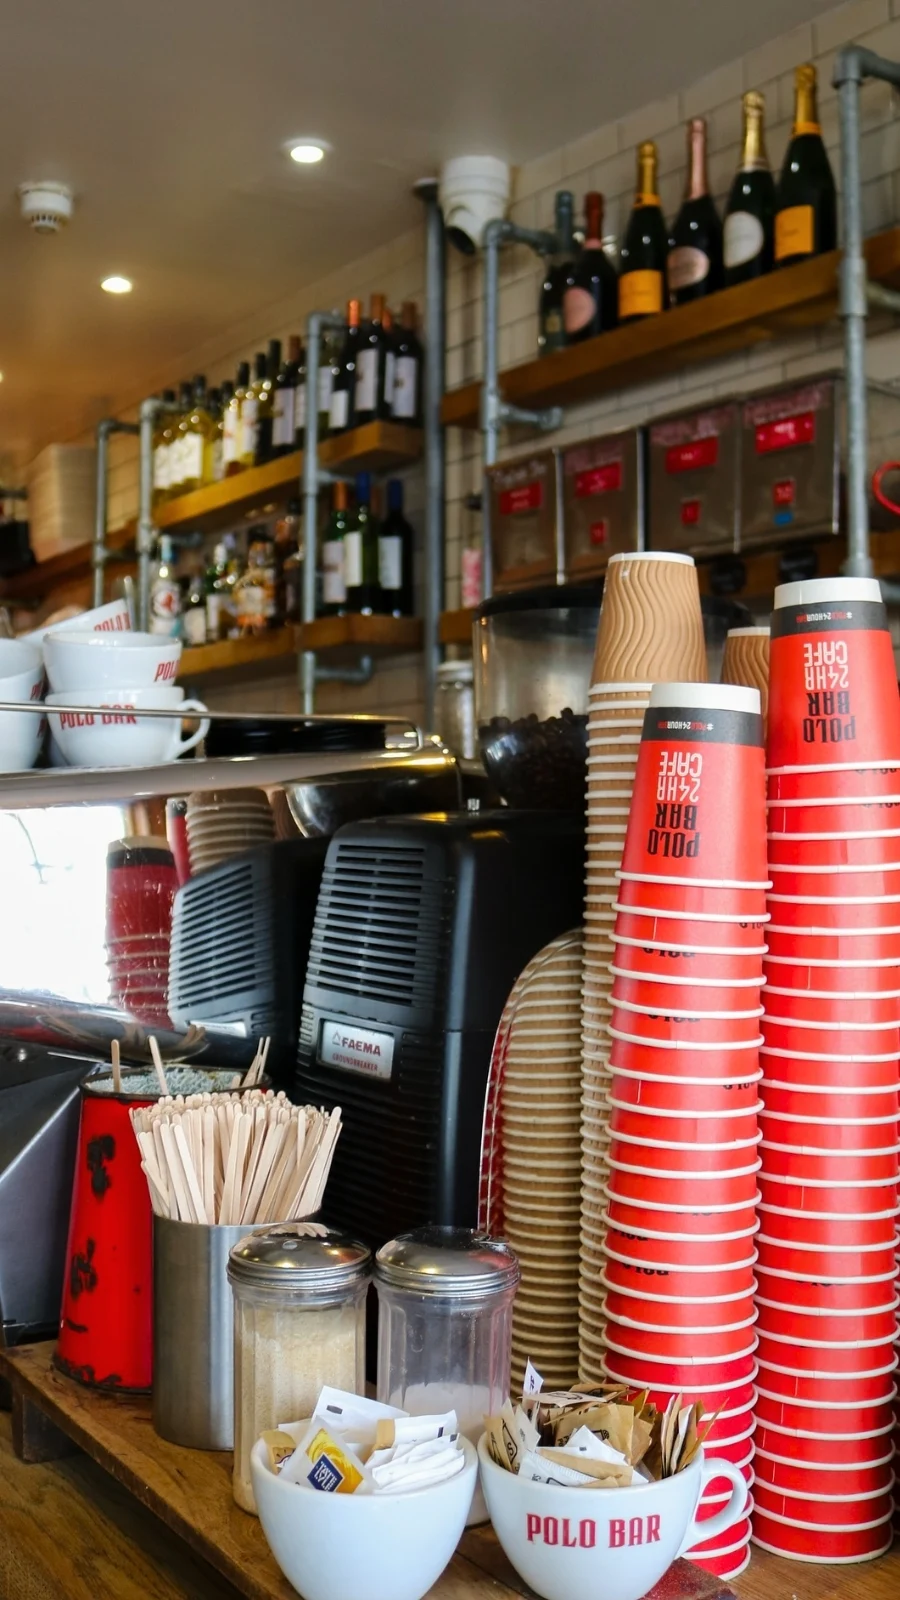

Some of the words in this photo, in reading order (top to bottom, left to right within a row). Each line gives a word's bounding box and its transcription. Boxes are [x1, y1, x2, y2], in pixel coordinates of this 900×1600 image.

[803, 641, 849, 666] CAFE
[805, 664, 850, 691] 24HR
[807, 690, 850, 717] BAR
[802, 716, 856, 743] POLO
[658, 751, 703, 777] CAFE
[656, 776, 701, 802] 24HR
[655, 802, 699, 830] BAR
[647, 829, 700, 858] POLO
[341, 1037, 381, 1057] FAEMA
[332, 1052, 378, 1072] GROUNDBREAKER
[526, 1513, 596, 1548] POLO
[608, 1514, 661, 1548] BAR
